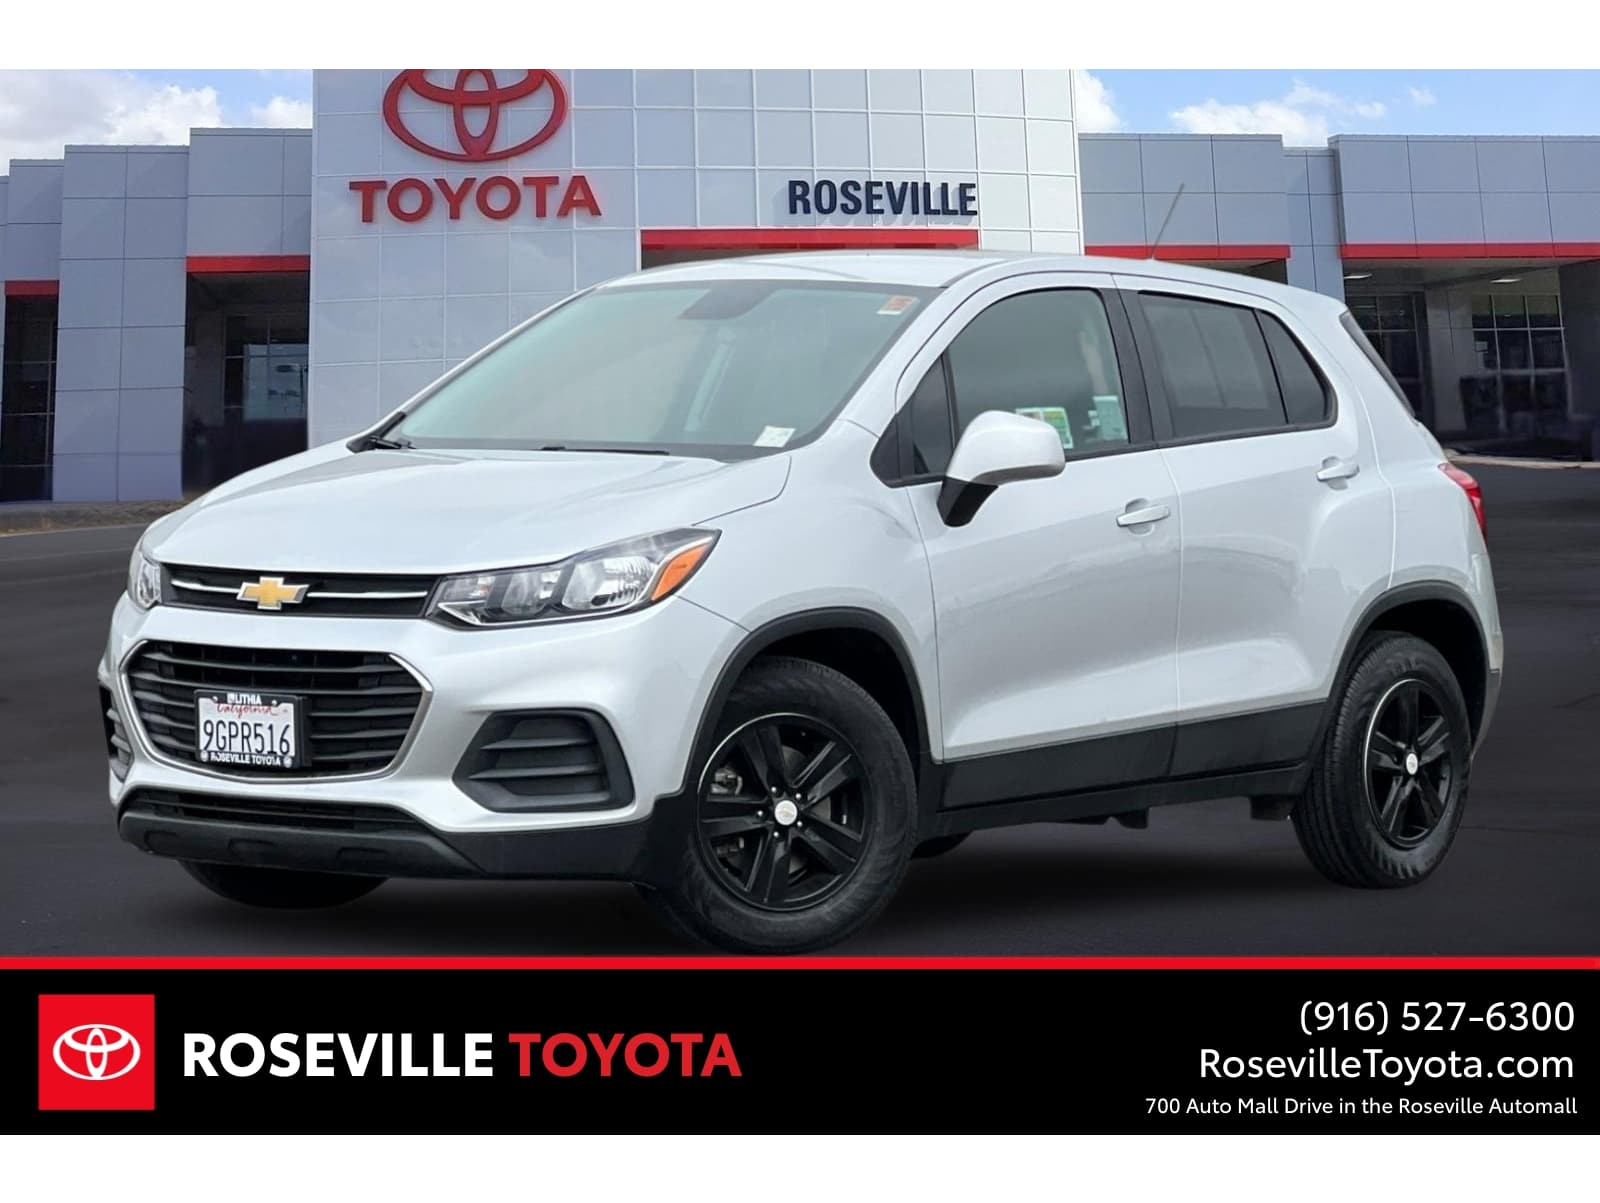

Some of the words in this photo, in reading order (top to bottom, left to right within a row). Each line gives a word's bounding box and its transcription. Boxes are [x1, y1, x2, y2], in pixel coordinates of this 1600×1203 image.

[349, 175, 602, 223] TOYOTA
[788, 180, 978, 216] ROSEVILLE
[217, 705, 273, 718] California
[235, 694, 262, 705] LITHIA
[203, 720, 291, 756] 9GPR516
[211, 752, 250, 764] ROSEVILLE
[252, 755, 281, 766] TOYOTA
